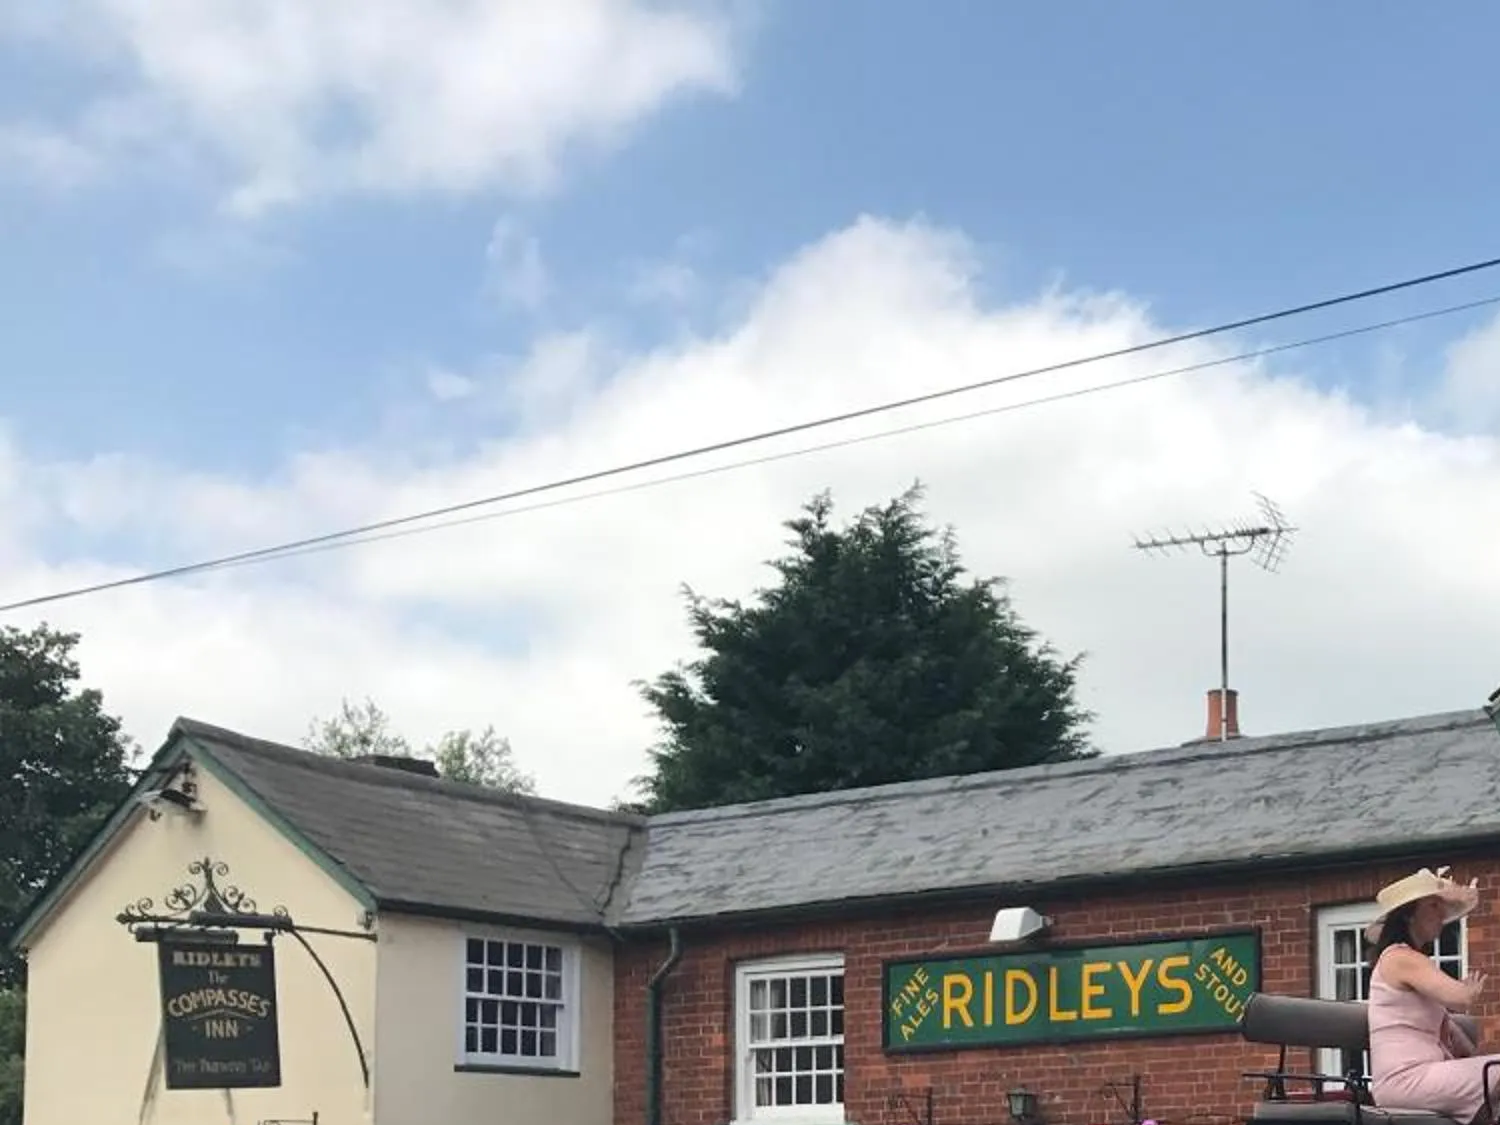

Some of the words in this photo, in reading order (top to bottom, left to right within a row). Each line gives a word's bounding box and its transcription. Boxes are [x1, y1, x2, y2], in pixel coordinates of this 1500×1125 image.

[1210, 946, 1247, 985] AND
[168, 988, 270, 1017] COMPASSES
[892, 967, 929, 1018] FINE
[901, 988, 939, 1041] ALES
[942, 956, 1193, 1029] RIDLEYS
[205, 1019, 238, 1038] INN
